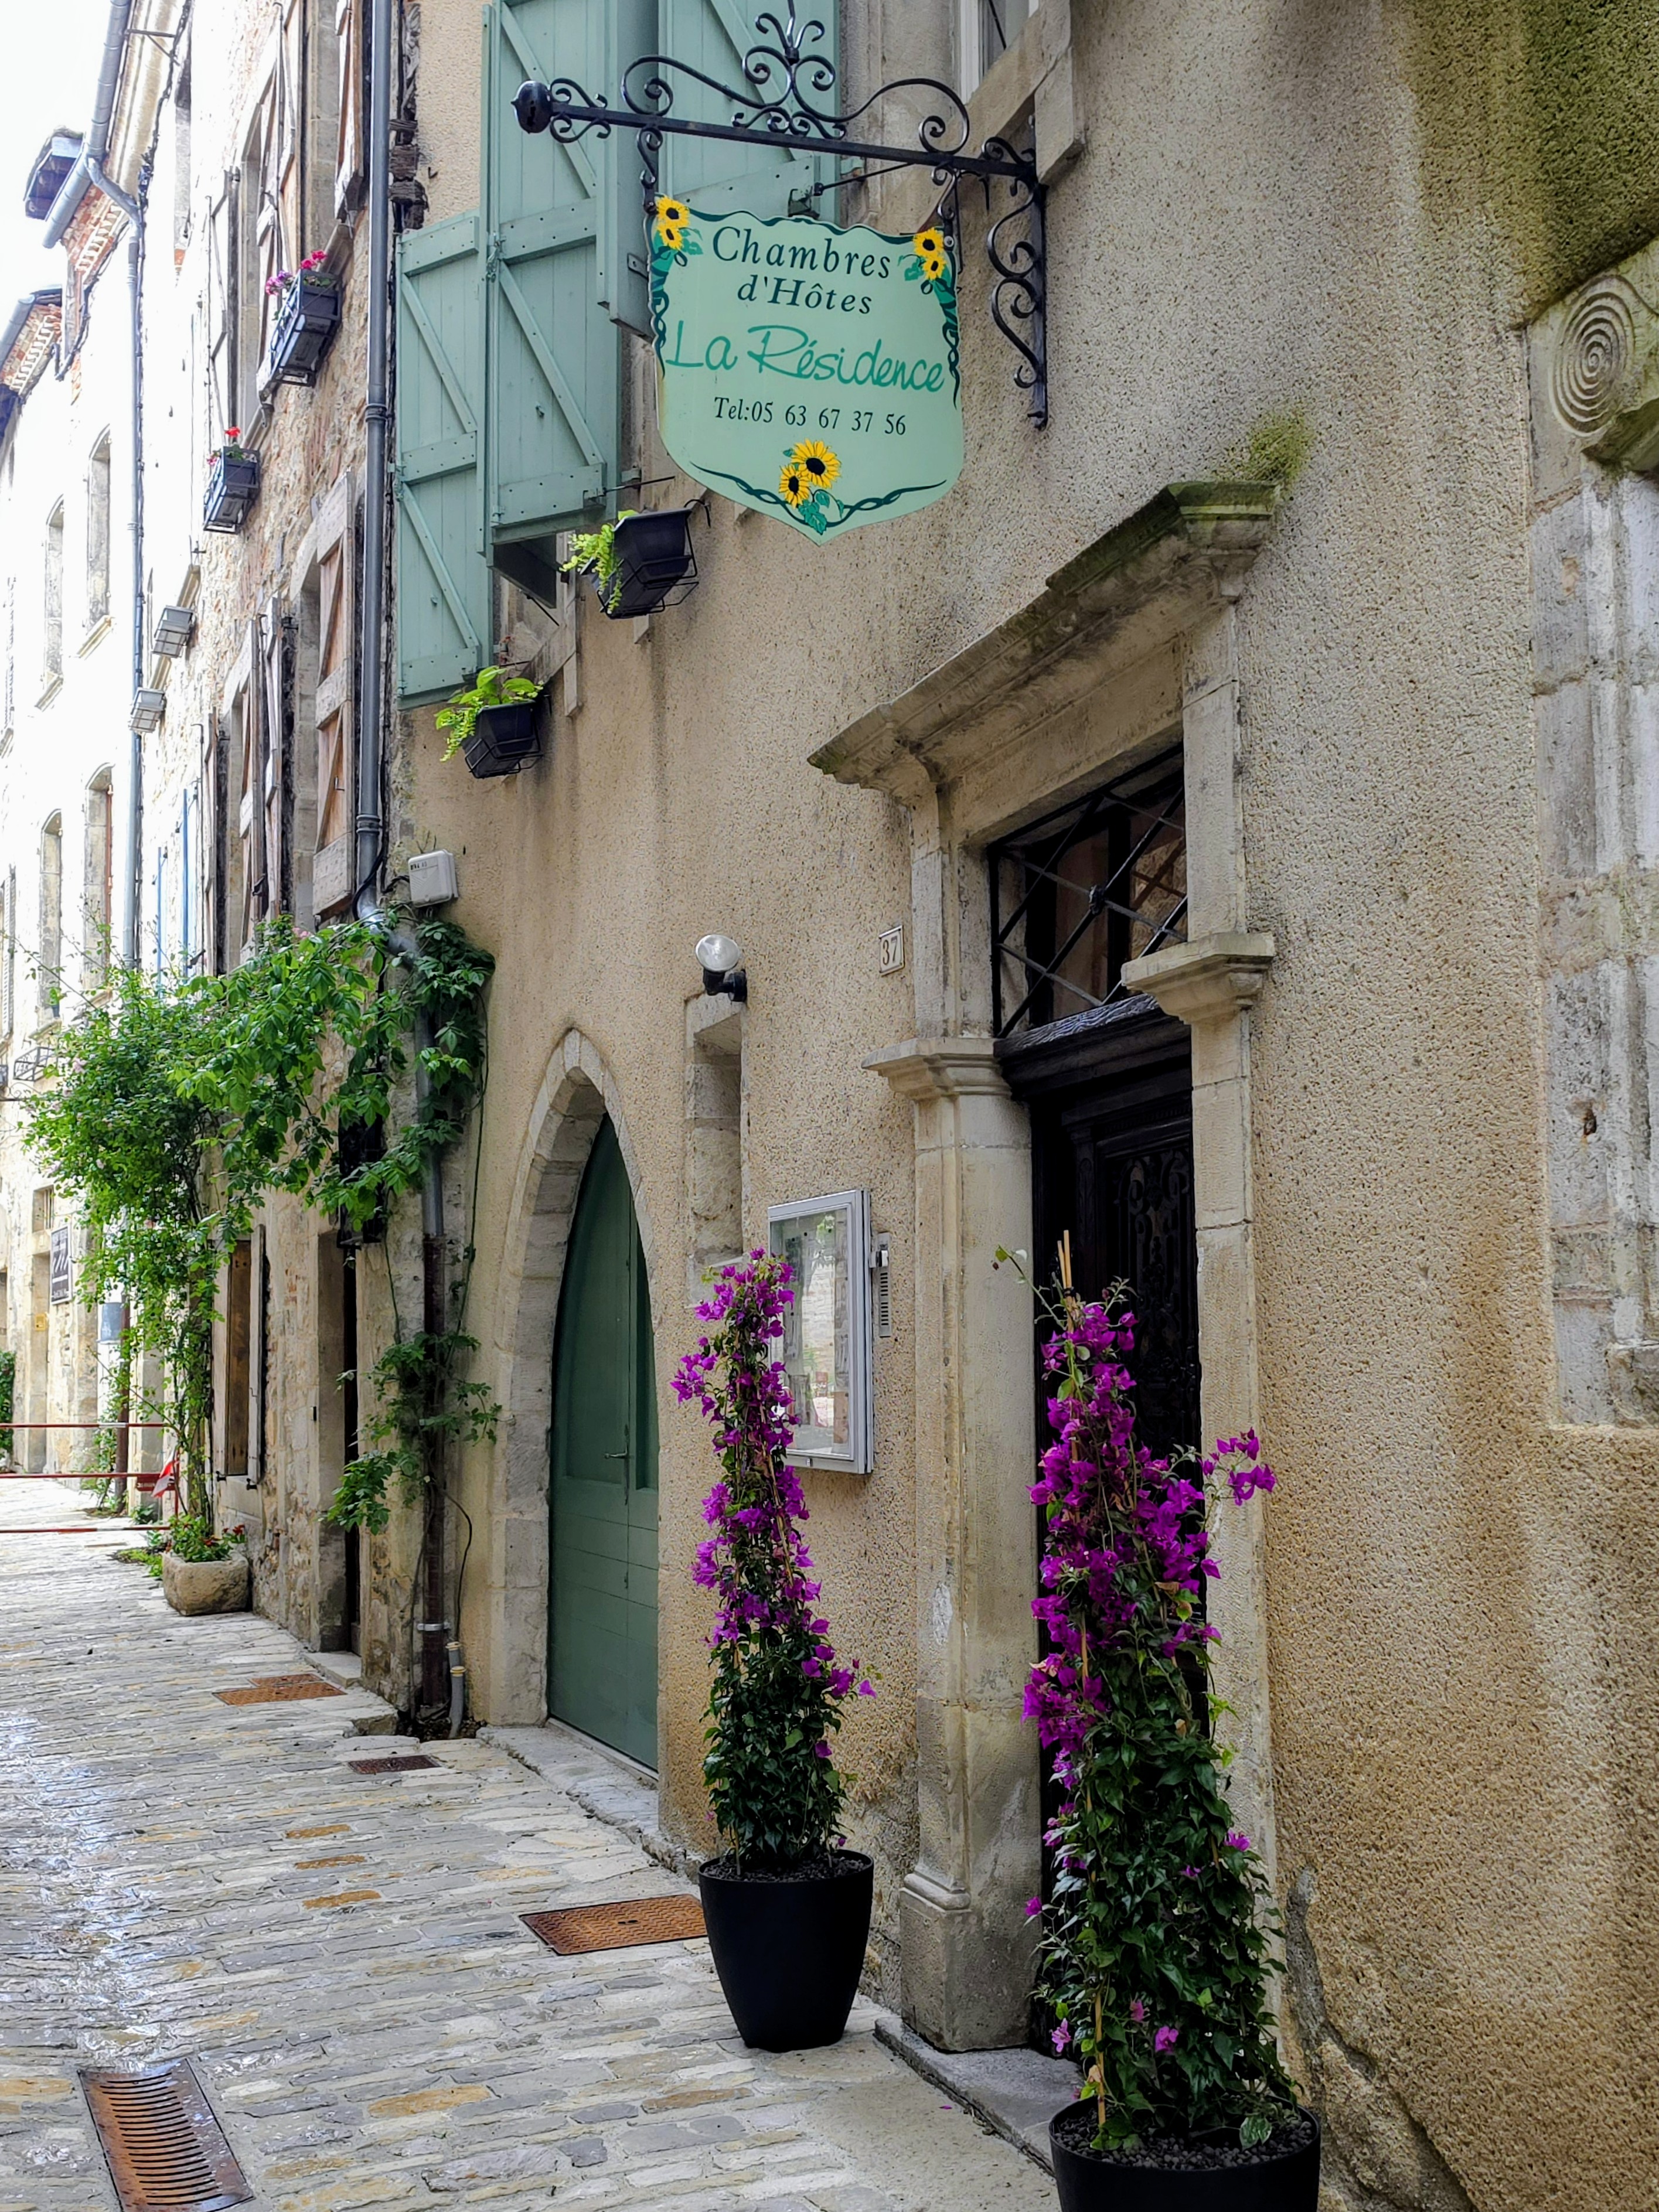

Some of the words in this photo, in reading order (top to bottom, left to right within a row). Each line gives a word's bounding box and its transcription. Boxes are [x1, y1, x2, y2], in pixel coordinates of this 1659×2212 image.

[713, 226, 891, 279] Chambres
[738, 274, 872, 314] d'Hôtes
[666, 320, 738, 371] La
[747, 325, 945, 393] Résidence
[785, 405, 807, 427] 63
[819, 408, 840, 429] 67
[851, 411, 873, 432] 37
[885, 414, 907, 435] 56
[883, 936, 898, 965] 37
